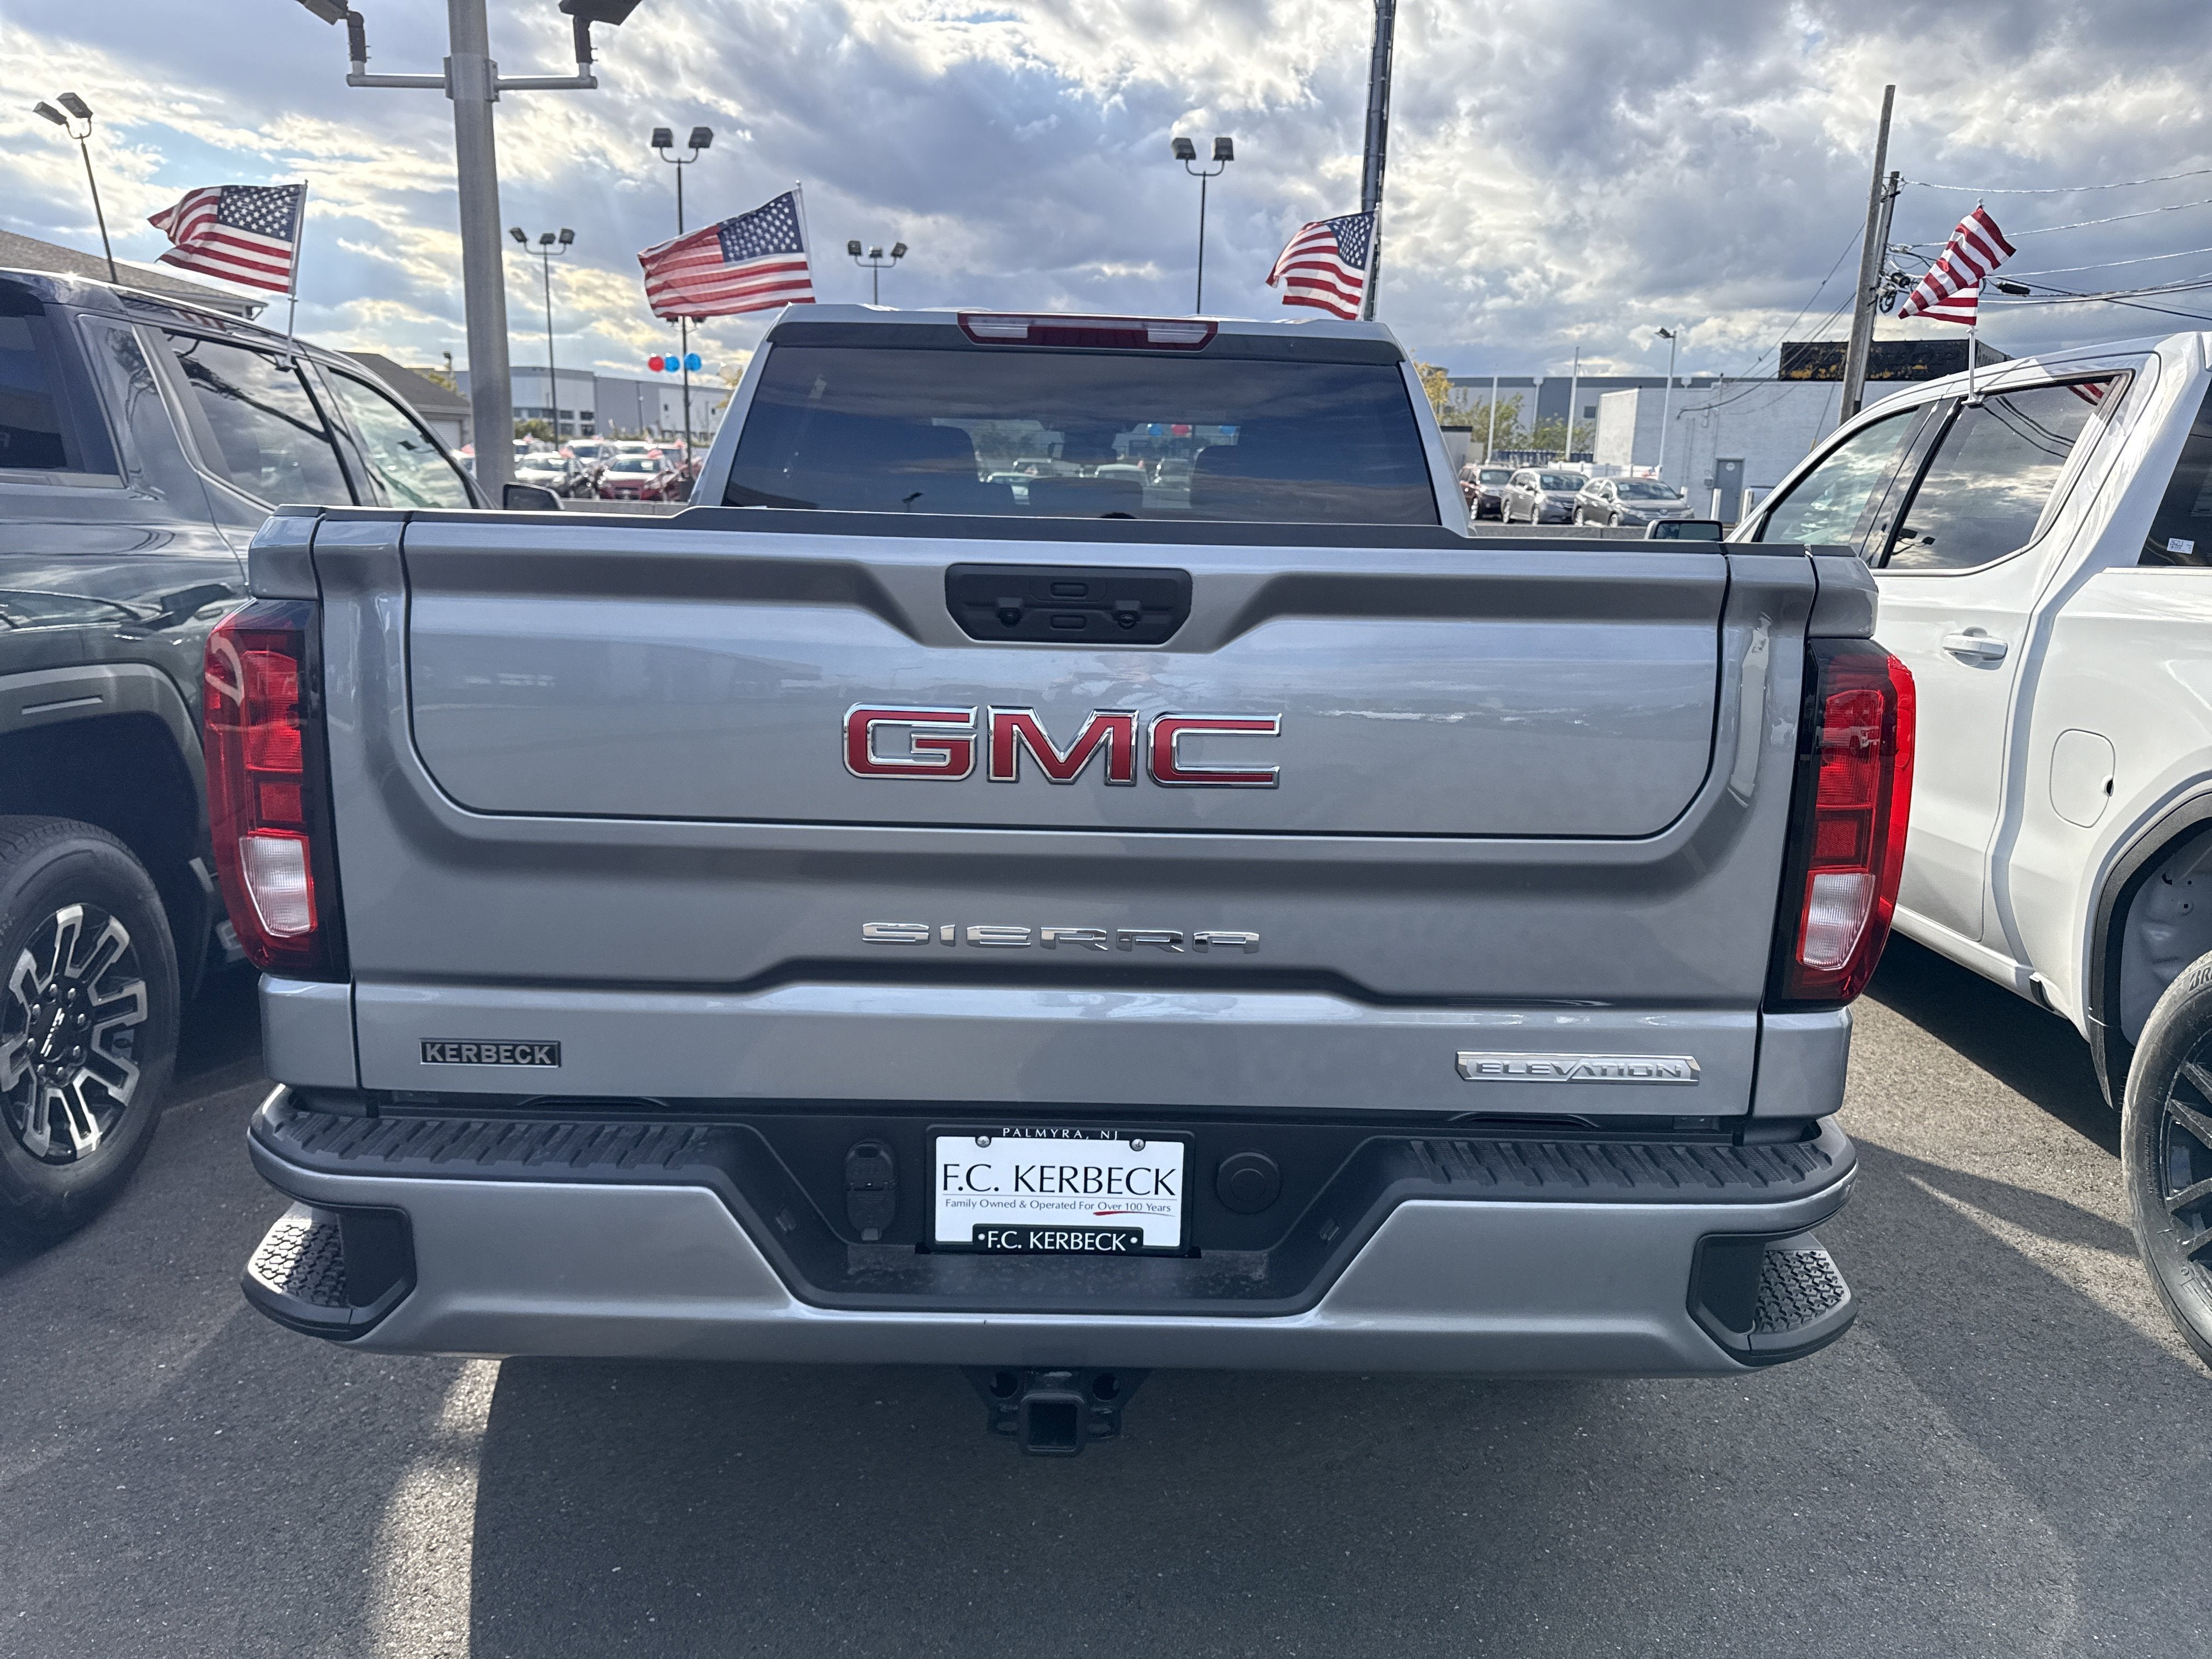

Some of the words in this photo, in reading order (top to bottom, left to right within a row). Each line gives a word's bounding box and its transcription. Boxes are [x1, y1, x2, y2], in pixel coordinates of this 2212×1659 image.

[843, 702, 1282, 789] GMC
[862, 922, 1260, 953] SIERRA
[426, 1043, 552, 1064] KERBECK
[1476, 1060, 1681, 1077] ELEVATION
[1002, 1127, 1089, 1140] PALMYRA,
[1101, 1130, 1118, 1141] NJ
[943, 1164, 999, 1192] F.C.
[1014, 1165, 1176, 1196] KERBECK
[945, 1199, 977, 1209] Family
[980, 1199, 1015, 1208] Owned
[1030, 1200, 1076, 1210] Operated
[1079, 1201, 1094, 1210] For
[1098, 1201, 1121, 1210] Over
[1126, 1203, 1142, 1211] 100
[1147, 1203, 1171, 1212] Years
[988, 1231, 1022, 1249] F.C.
[1030, 1231, 1126, 1251] KERBECK
